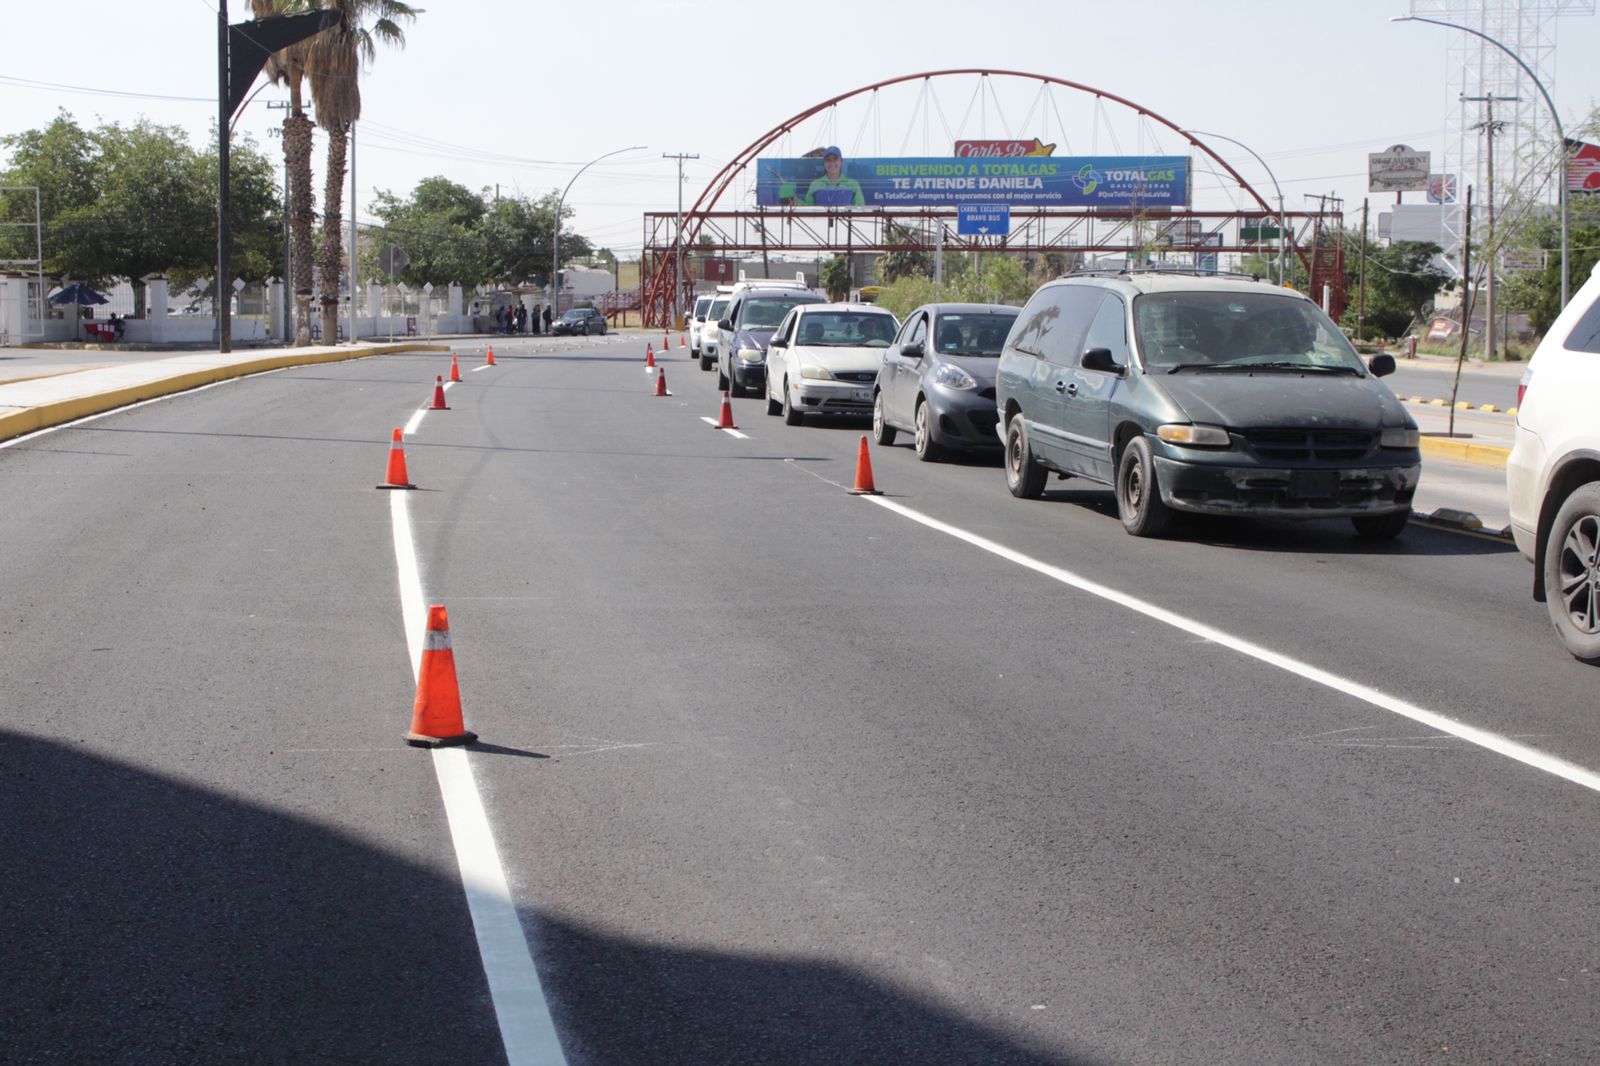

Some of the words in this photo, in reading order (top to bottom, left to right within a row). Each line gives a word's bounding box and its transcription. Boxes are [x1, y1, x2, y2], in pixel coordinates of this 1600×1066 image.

[876, 164, 965, 176] BIENVENIDO
[968, 164, 979, 176] A
[1105, 171, 1175, 181] TOTALGAS
[892, 177, 910, 189] TE
[914, 177, 976, 189] ATIENDE
[979, 177, 1043, 189] DANIELA
[918, 192, 944, 201] siempre
[955, 193, 991, 201] esperamos
[1014, 192, 1033, 201] mejor
[1035, 191, 1062, 199] servicio
